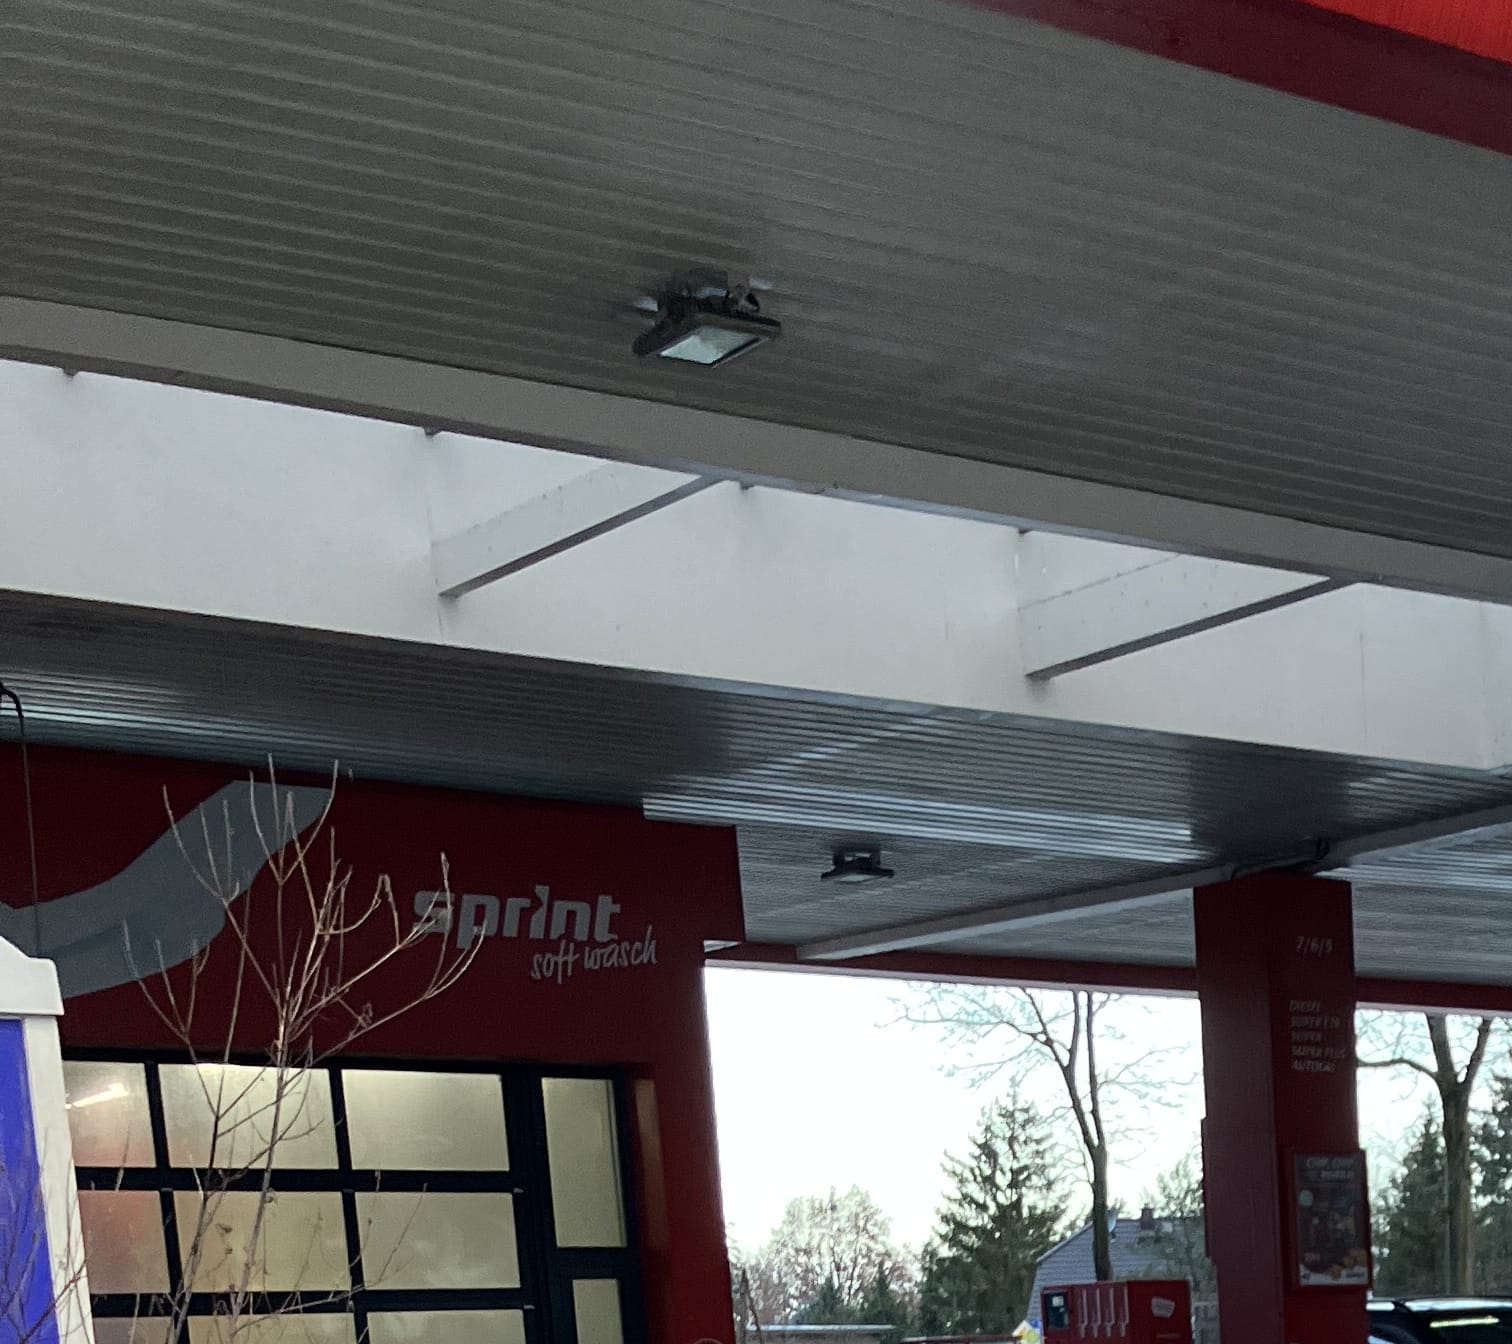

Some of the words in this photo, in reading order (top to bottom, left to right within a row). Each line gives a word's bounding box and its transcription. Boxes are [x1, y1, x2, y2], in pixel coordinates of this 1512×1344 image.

[413, 884, 621, 950] sprint
[530, 938, 580, 985] soft
[584, 924, 658, 970] wasch
